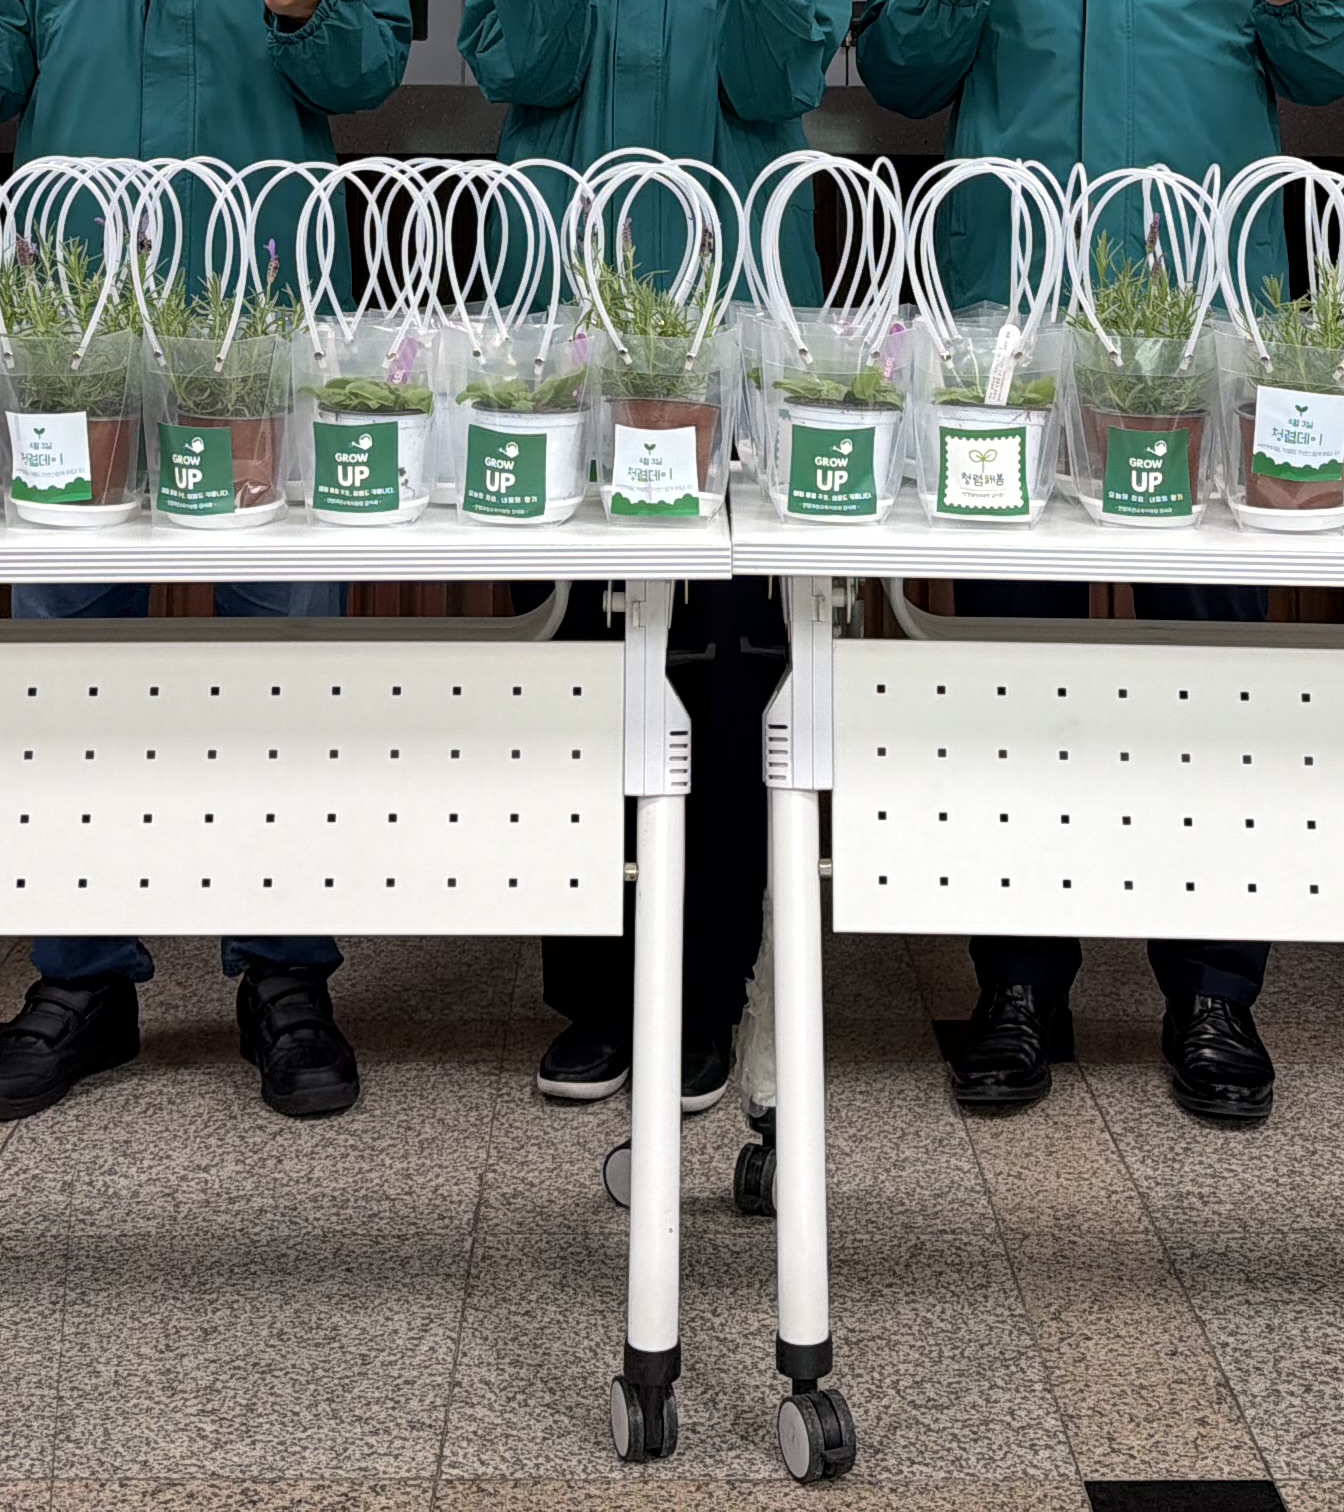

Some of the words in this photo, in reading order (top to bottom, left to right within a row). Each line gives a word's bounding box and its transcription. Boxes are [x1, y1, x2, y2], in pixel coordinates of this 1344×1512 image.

[172, 453, 200, 466] GROW
[335, 453, 368, 462] GROW
[485, 457, 514, 470] GROW
[815, 457, 848, 467] GROW
[1129, 458, 1162, 468] GROW
[175, 467, 202, 489] UP
[337, 466, 370, 487] UP
[486, 471, 516, 493] UP
[816, 470, 848, 491] UP
[1131, 471, 1162, 492] UP
